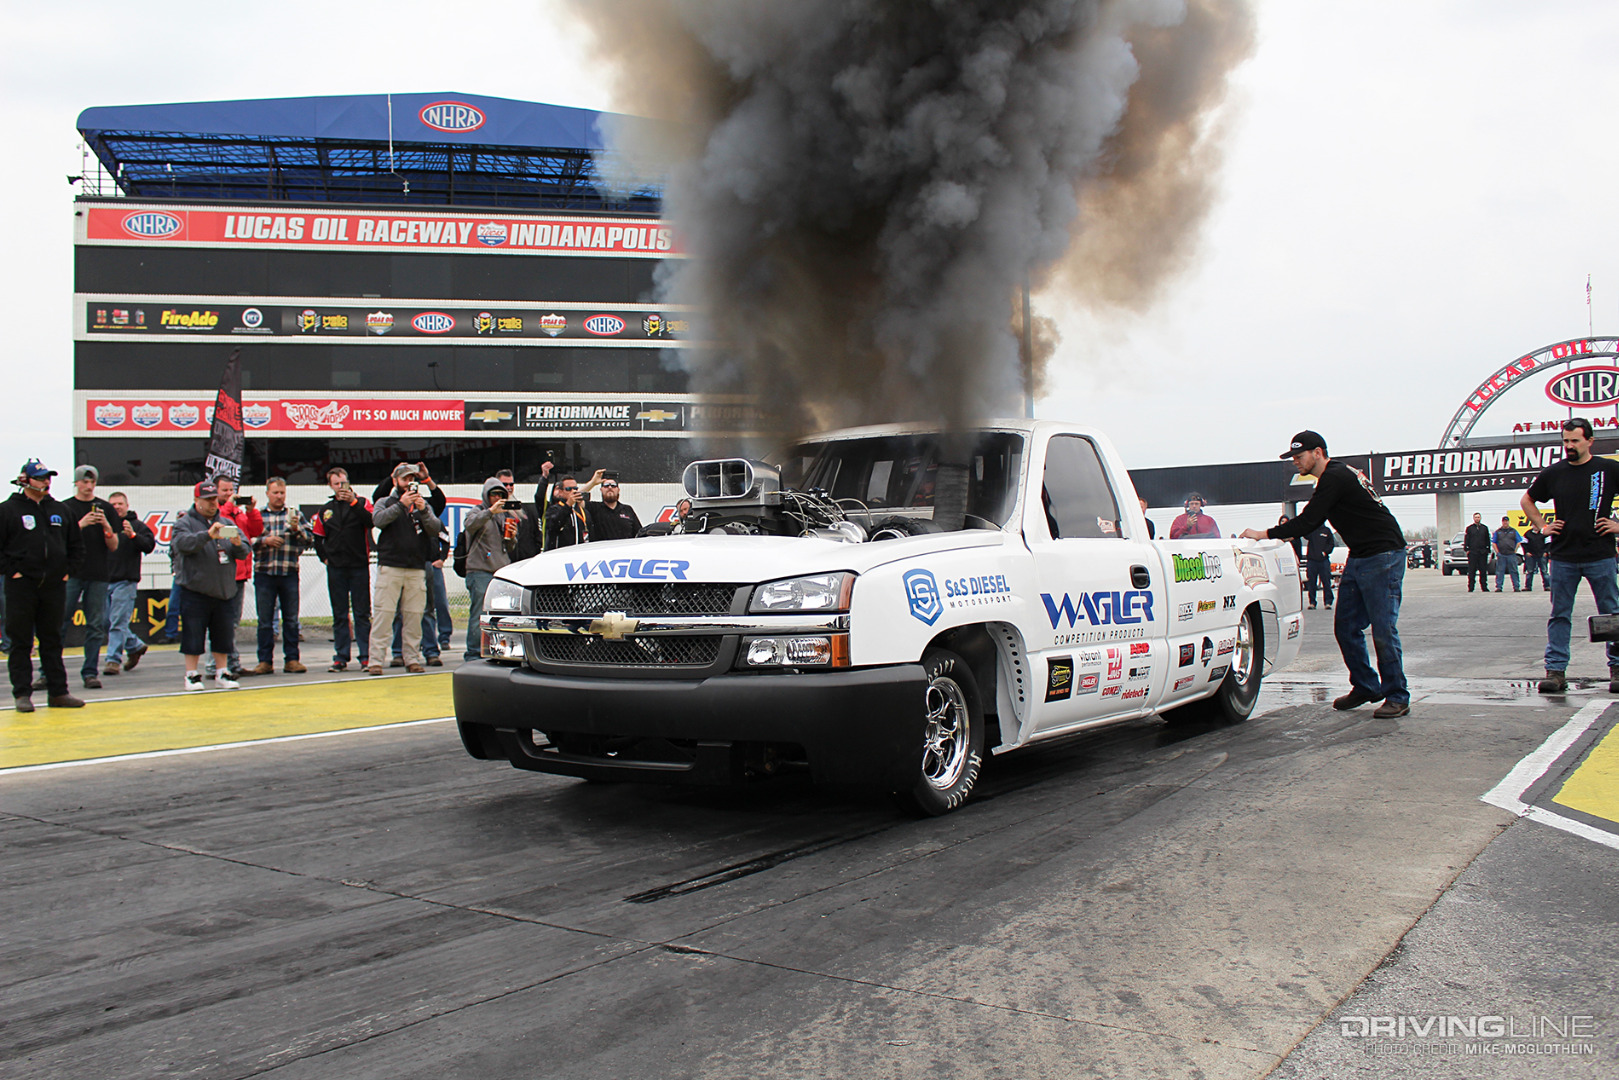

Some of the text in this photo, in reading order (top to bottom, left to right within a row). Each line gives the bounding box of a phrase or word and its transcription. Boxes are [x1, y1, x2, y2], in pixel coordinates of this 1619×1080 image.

[429, 106, 477, 128] NHRA
[131, 213, 174, 235] NHRA
[224, 215, 474, 244] LUCAS OIL RACEWAY
[509, 223, 672, 250] INDIANAPOLIS
[161, 309, 219, 326] FireAde
[418, 316, 451, 330] NHRA
[590, 318, 621, 332] NHRA
[1466, 339, 1593, 412] LUCAS OIL
[353, 410, 371, 421] IT'S
[374, 410, 387, 421] SO
[390, 410, 420, 421] MUCH
[526, 406, 630, 419] PERFORMANCE
[1513, 422, 1532, 433] AT
[205, 453, 241, 478] ULTIMATE
[1384, 445, 1567, 477] PERFORMANC
[1384, 480, 1448, 492] VEHICLES
[1464, 477, 1505, 488] PARTS
[565, 559, 689, 581] WAGLER
[1172, 552, 1222, 583] DieselOps
[945, 574, 1010, 598] S&S DIESEL
[950, 595, 1012, 609] MOTORSPORT
[1040, 590, 1154, 630] WAGLER
[1223, 595, 1236, 609] NX
[1054, 628, 1145, 645] COMPETITION PRODUCTS
[1079, 649, 1102, 662] vibrant
[1121, 688, 1144, 700] ridetech
